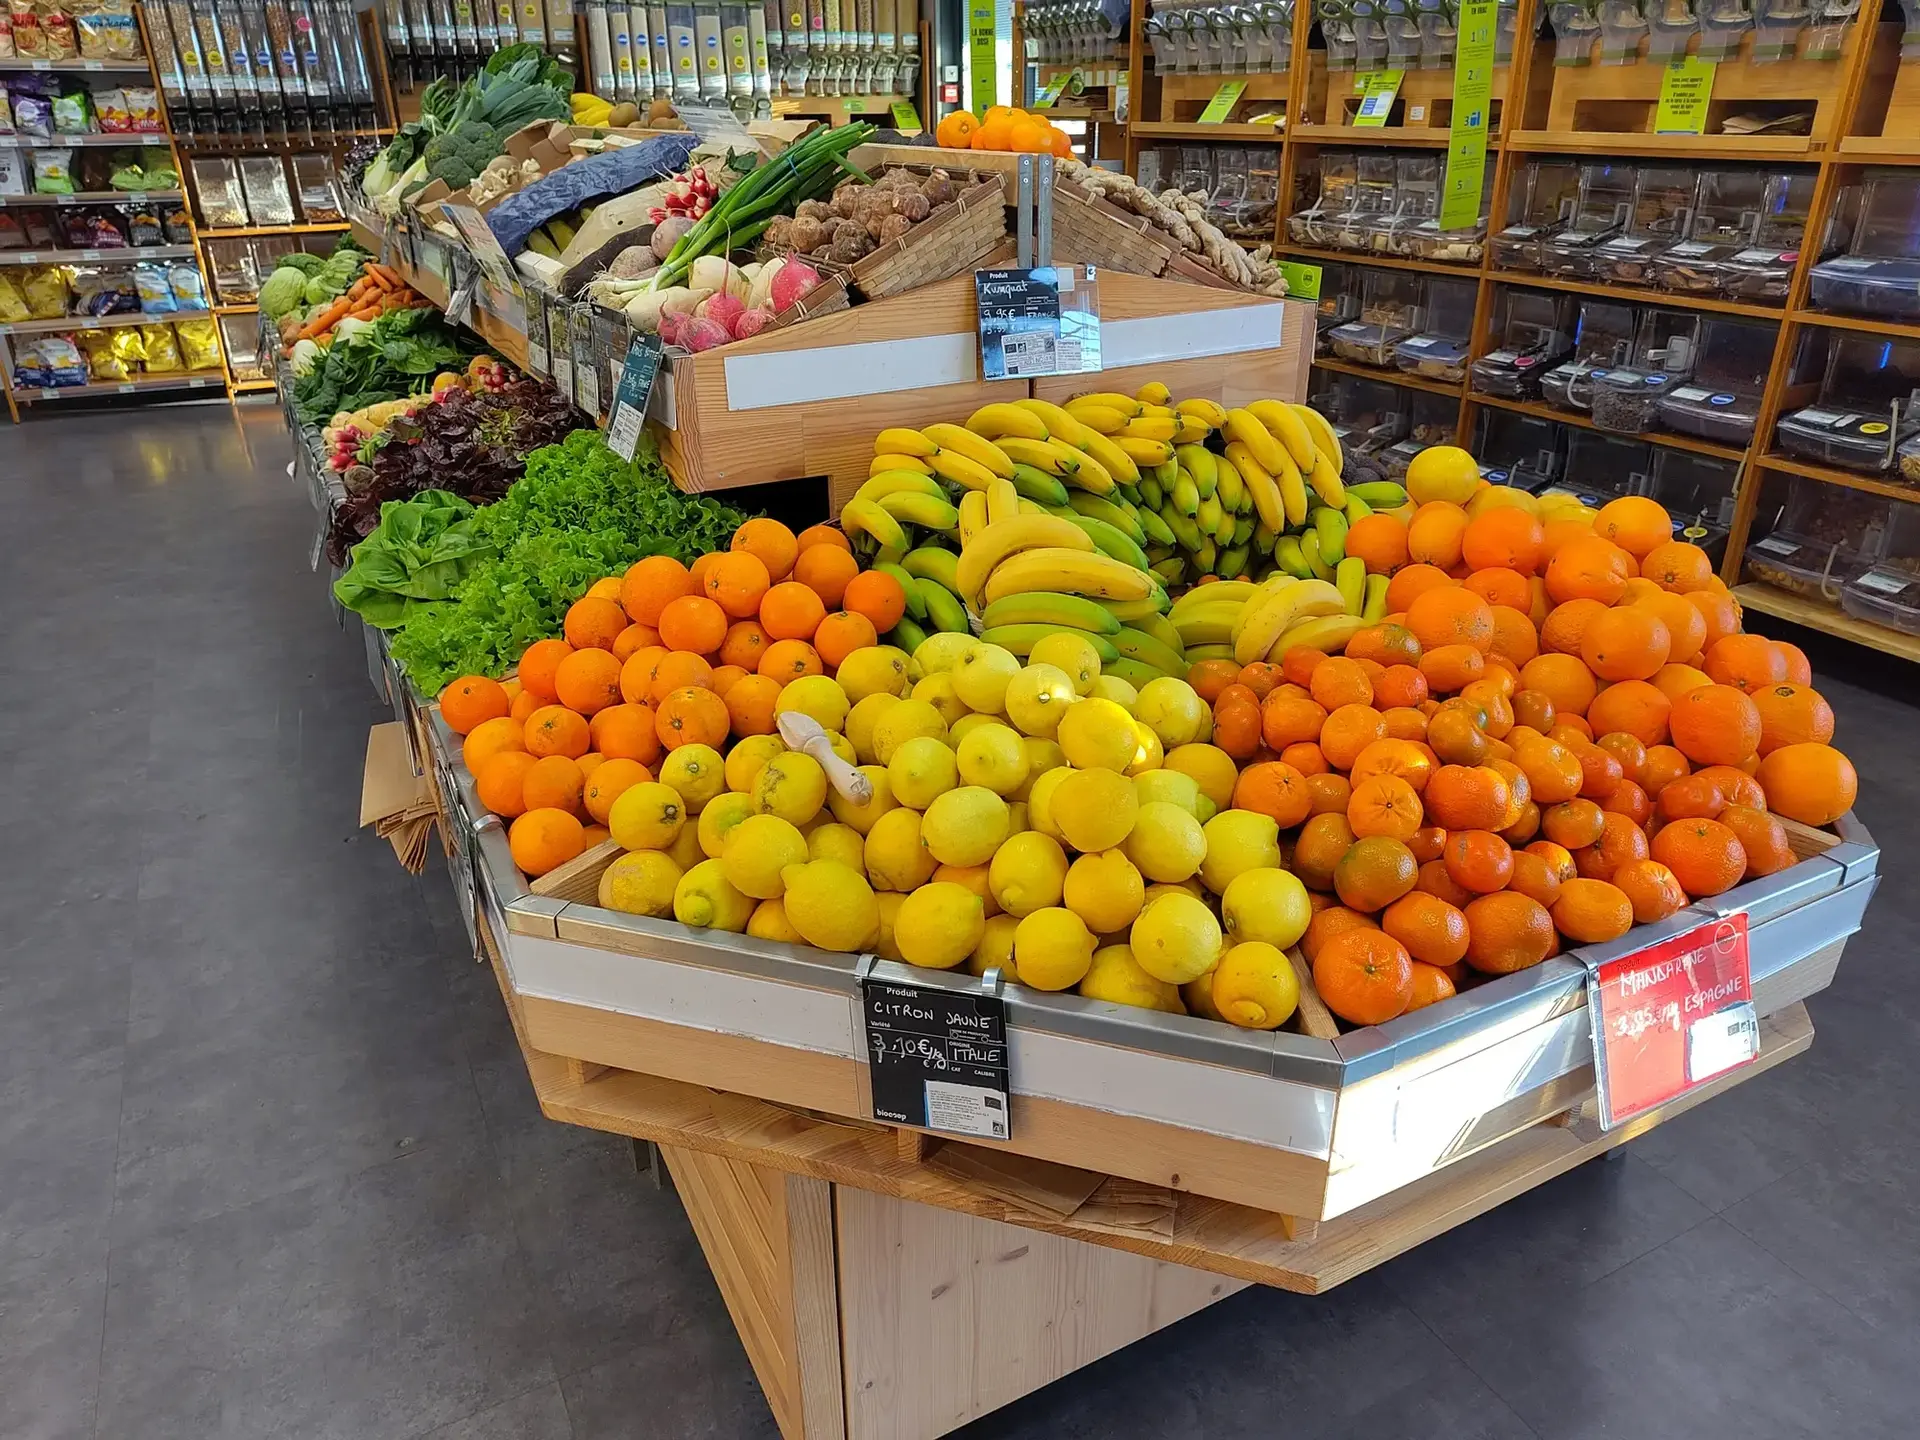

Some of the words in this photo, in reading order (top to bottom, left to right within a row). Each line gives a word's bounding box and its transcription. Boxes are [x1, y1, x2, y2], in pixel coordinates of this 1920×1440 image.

[1470, 31, 1476, 42] 1
[1467, 69, 1474, 81] 2
[1463, 116, 1470, 127] 3
[1461, 146, 1467, 156] 4
[1457, 180, 1463, 190] 5
[983, 280, 1028, 299] Kumquat
[886, 987, 918, 998] Produit
[1684, 976, 1743, 1014] ESPAGNE
[873, 1001, 935, 1021] CITRON
[945, 1011, 992, 1029] JAUNE
[948, 1041, 971, 1049] ORIGINE
[953, 1047, 1001, 1061] ITALIE
[973, 1069, 996, 1078] CALIBRE
